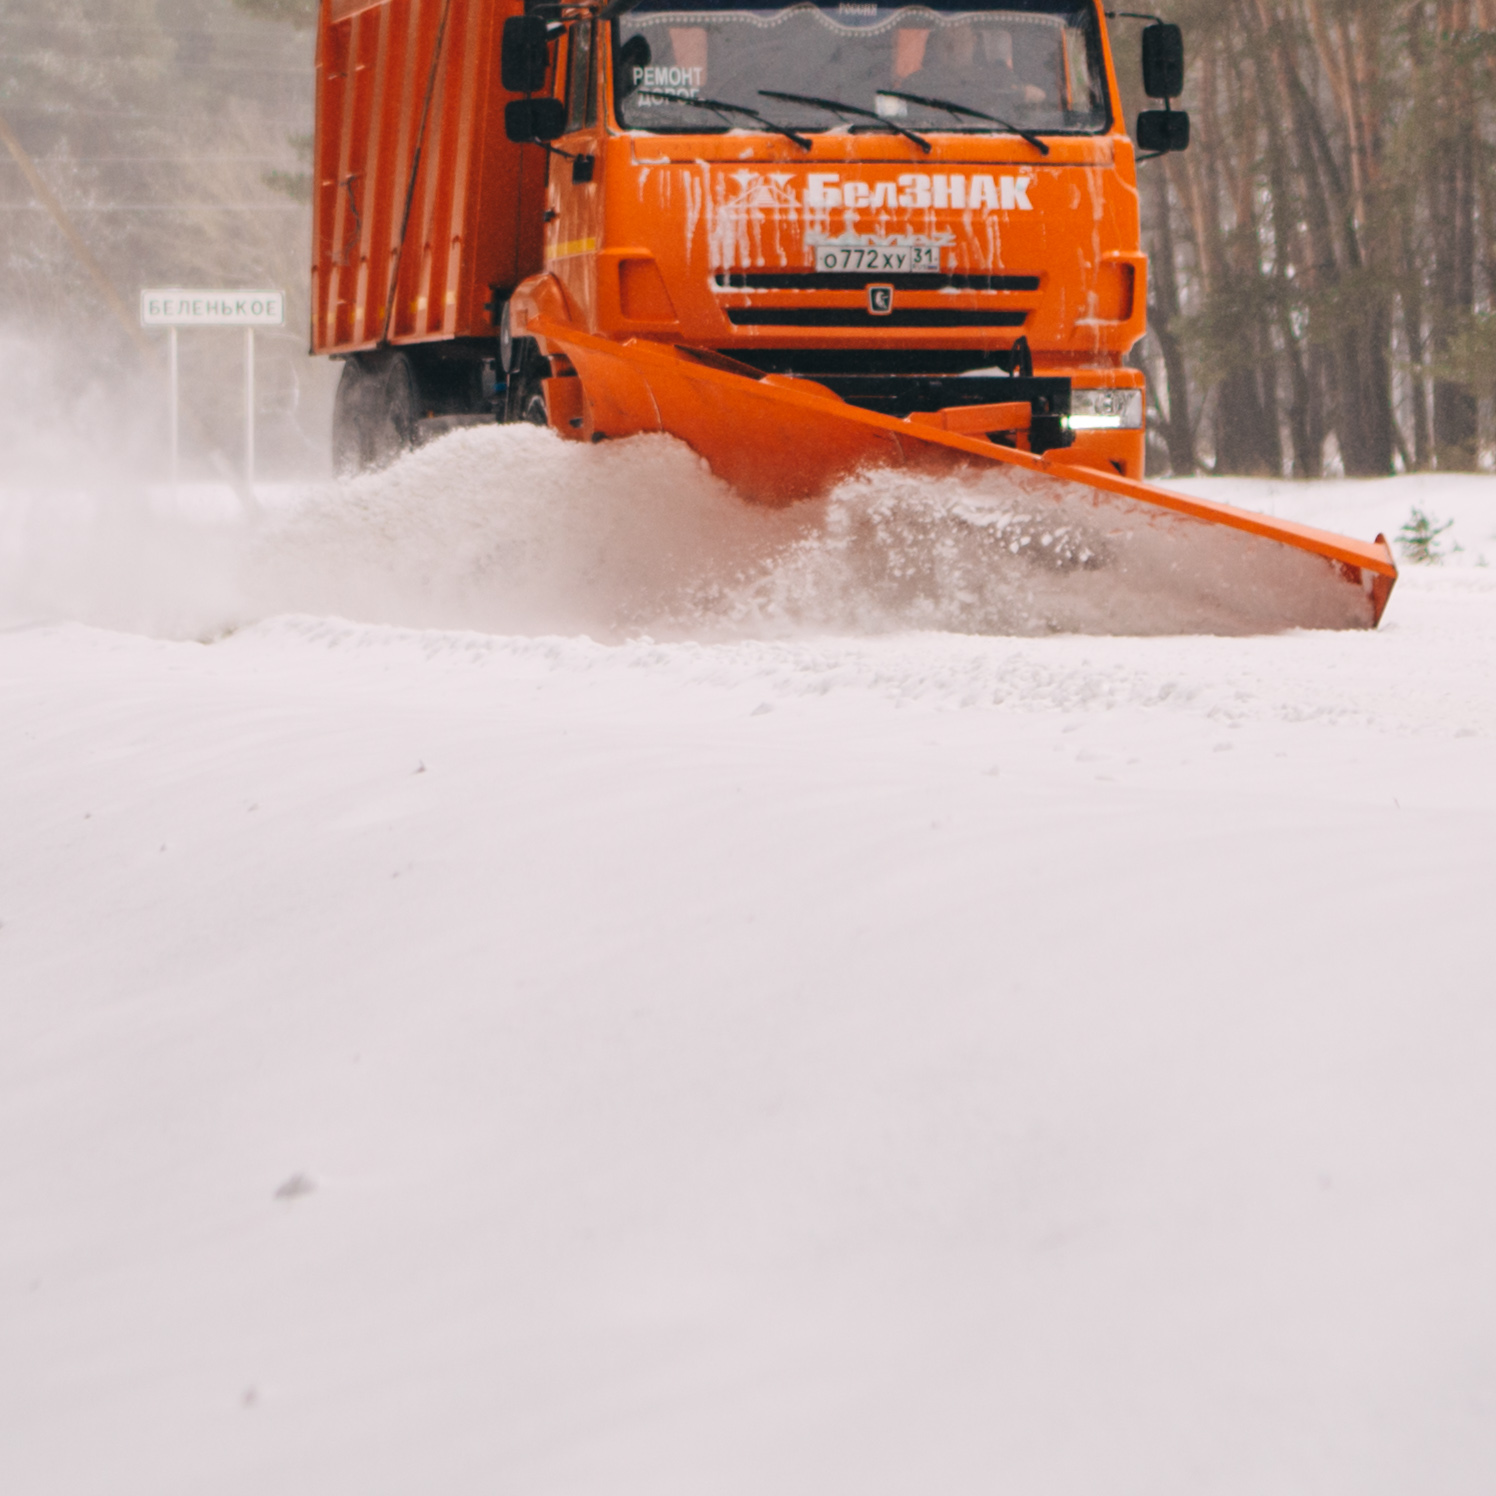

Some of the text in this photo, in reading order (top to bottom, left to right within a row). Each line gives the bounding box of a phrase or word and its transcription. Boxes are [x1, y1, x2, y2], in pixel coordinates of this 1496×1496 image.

[632, 66, 703, 86] РЕМОНТ
[807, 173, 1033, 210] БелЗНАК
[914, 248, 932, 263] 31
[148, 300, 277, 316] БЕЛЕНЬКОЕ
